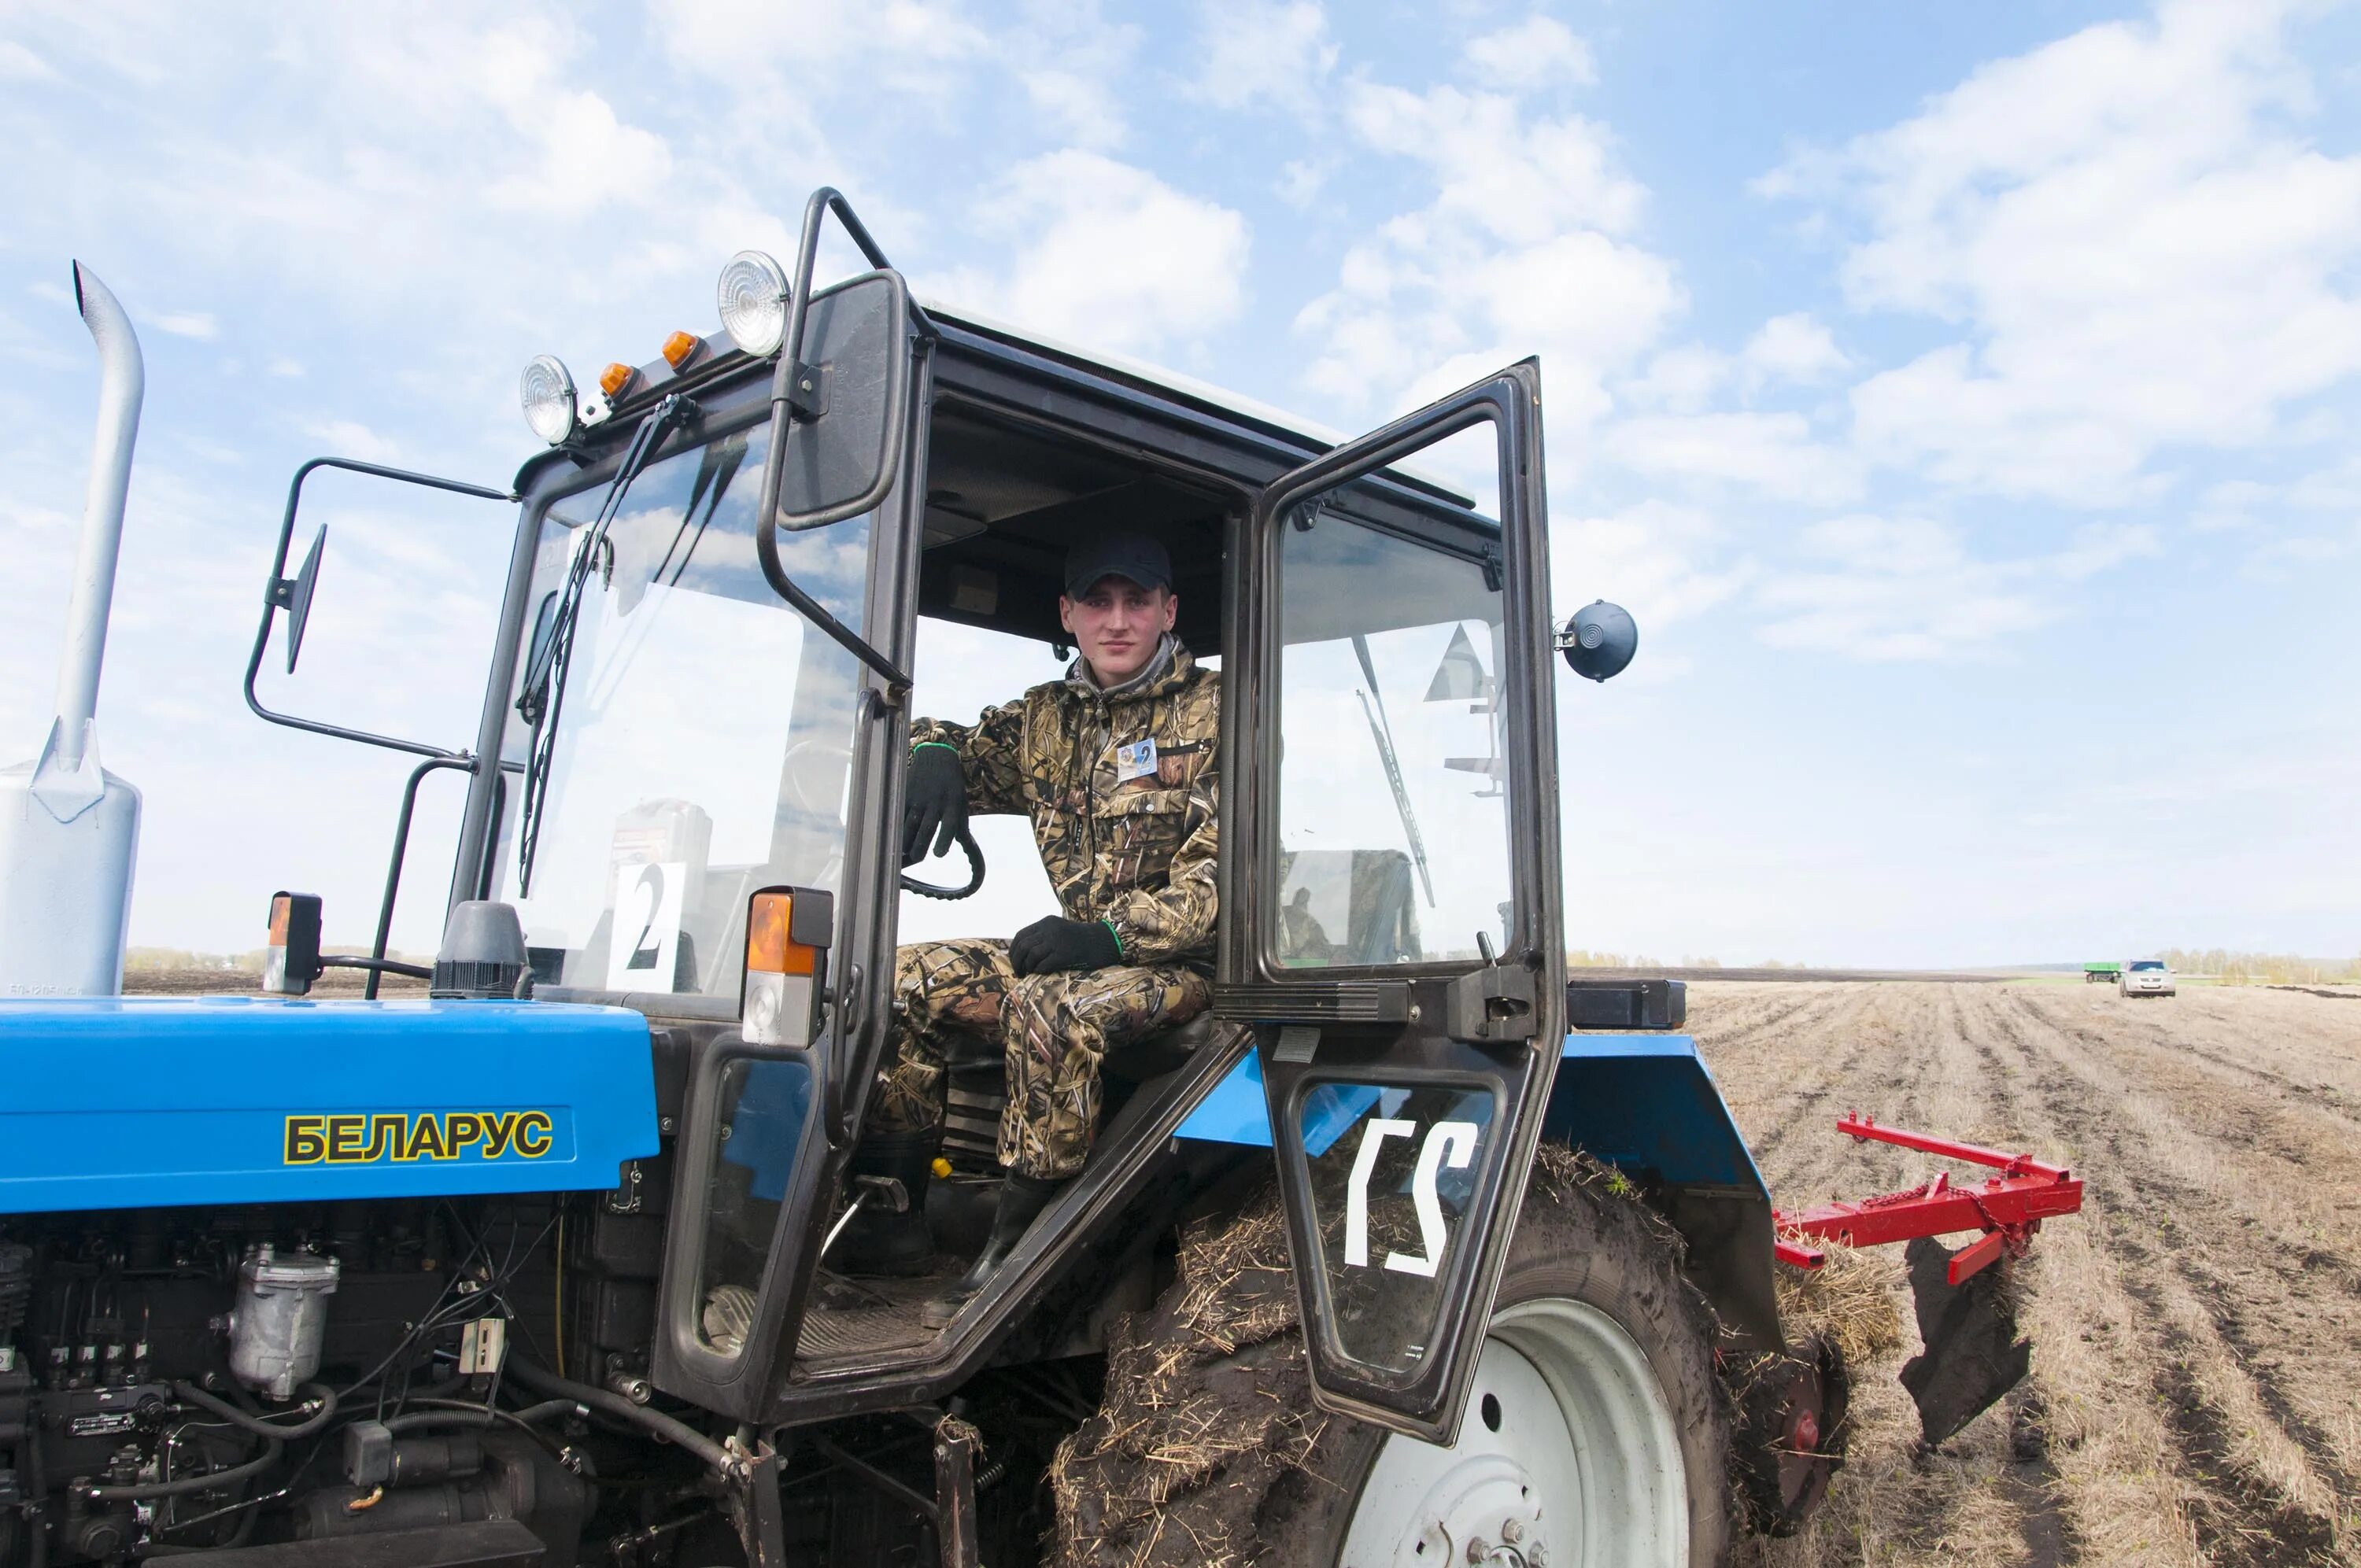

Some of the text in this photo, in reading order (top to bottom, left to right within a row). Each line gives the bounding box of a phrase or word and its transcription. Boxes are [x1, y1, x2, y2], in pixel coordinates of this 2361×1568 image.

[1140, 745, 1151, 770] 2
[626, 862, 665, 970] 2
[284, 1111, 553, 1165] БЕЛАРУС
